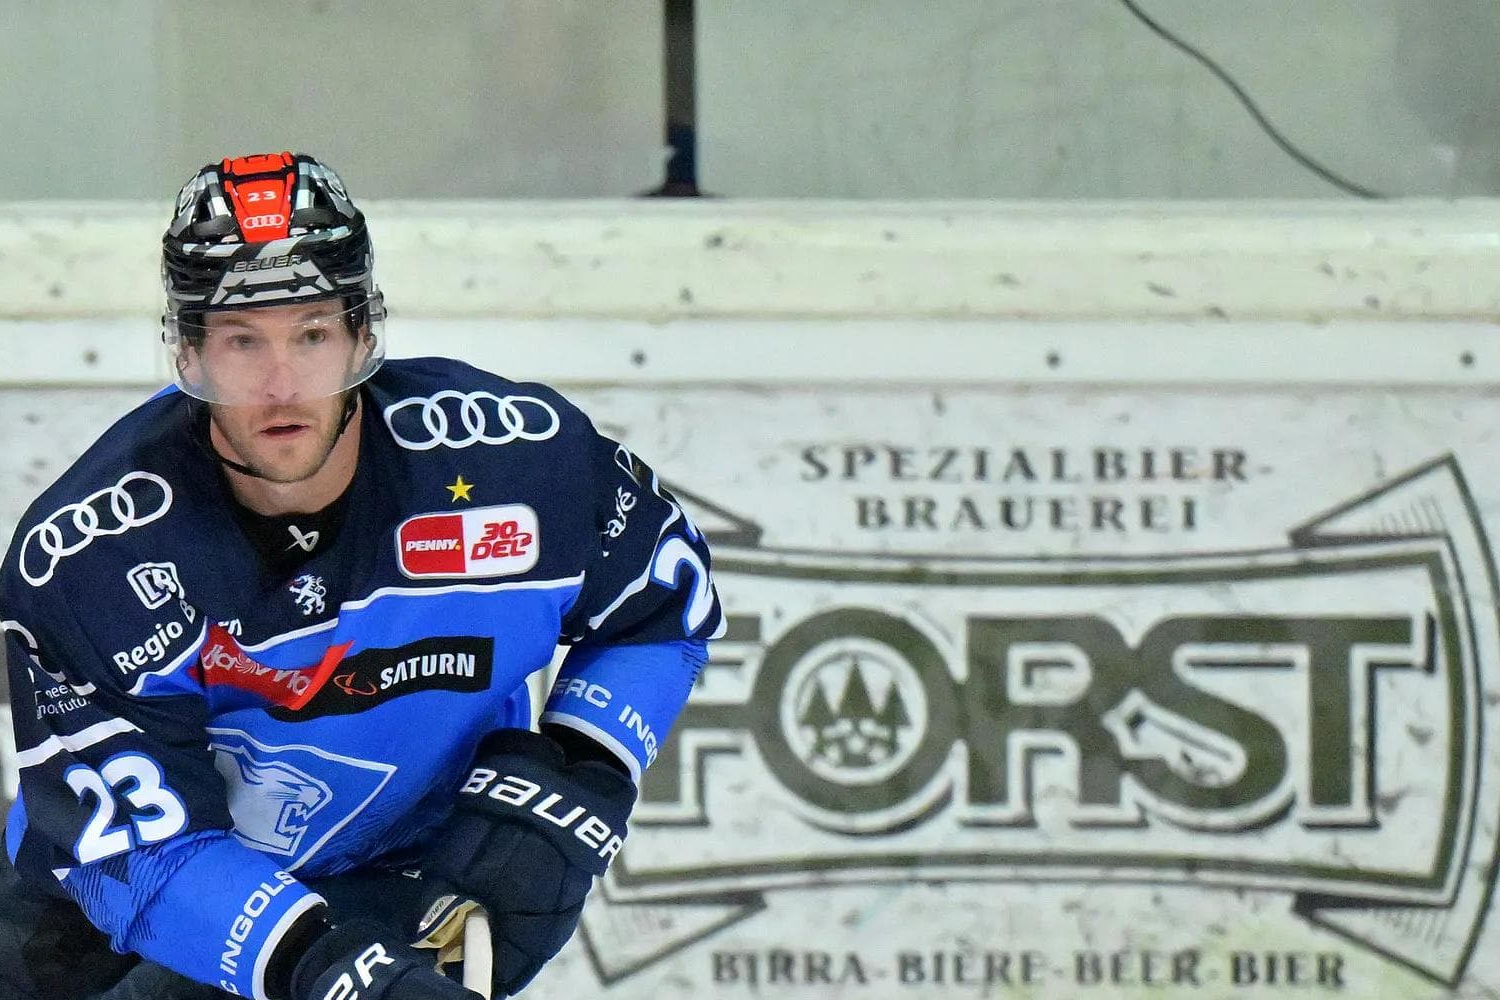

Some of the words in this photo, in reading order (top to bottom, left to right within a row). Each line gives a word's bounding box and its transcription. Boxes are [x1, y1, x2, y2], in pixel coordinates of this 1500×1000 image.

[247, 190, 277, 202] 23
[481, 520, 518, 542] 30
[854, 495, 1198, 530] BRAUEREI
[470, 533, 532, 560] DEL
[650, 522, 714, 637] 2
[113, 621, 183, 675] Regio
[380, 653, 475, 690] SATURN
[635, 605, 1436, 833] FORST
[63, 751, 189, 865] 23
[459, 768, 624, 858] BAUER
